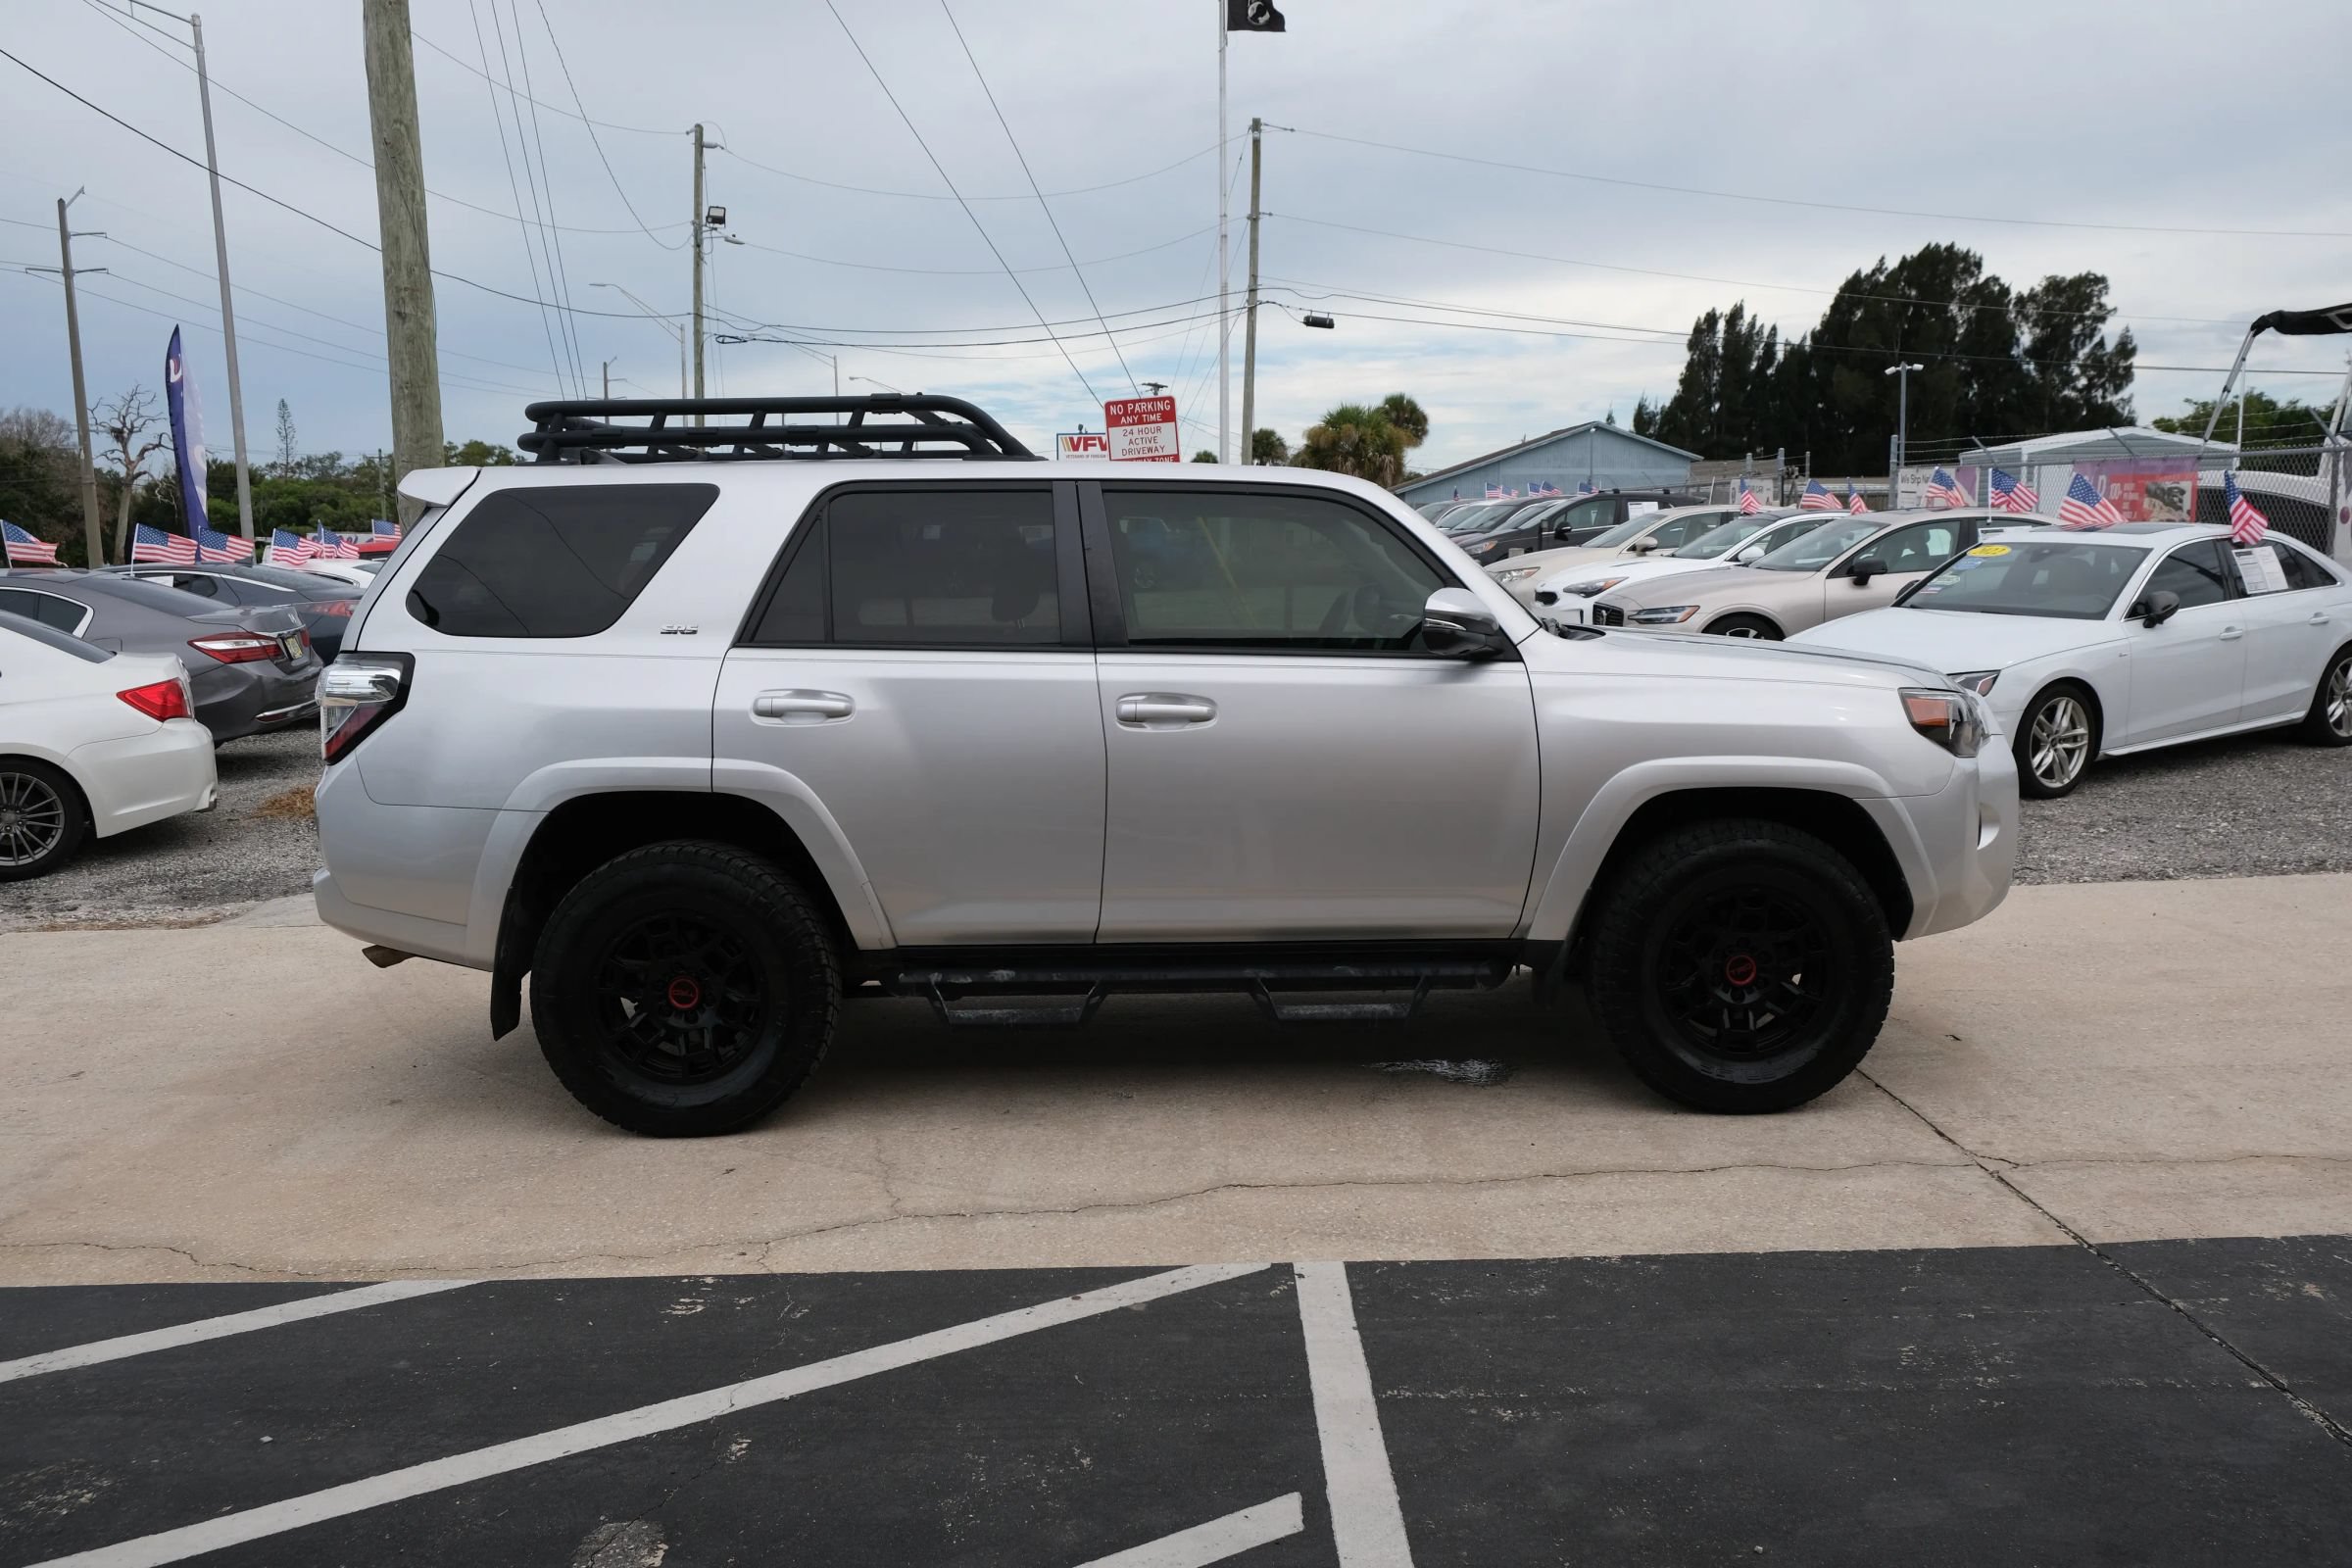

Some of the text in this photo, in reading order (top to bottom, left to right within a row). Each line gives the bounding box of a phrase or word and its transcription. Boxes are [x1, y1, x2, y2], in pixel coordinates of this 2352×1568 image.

[1109, 400, 1171, 416] NO PARKING
[1120, 413, 1162, 424] ANY TIME
[1122, 426, 1162, 437] 24 HOUR
[1128, 436, 1158, 446] ACTIVE
[1121, 445, 1165, 457] DRIVEWAY
